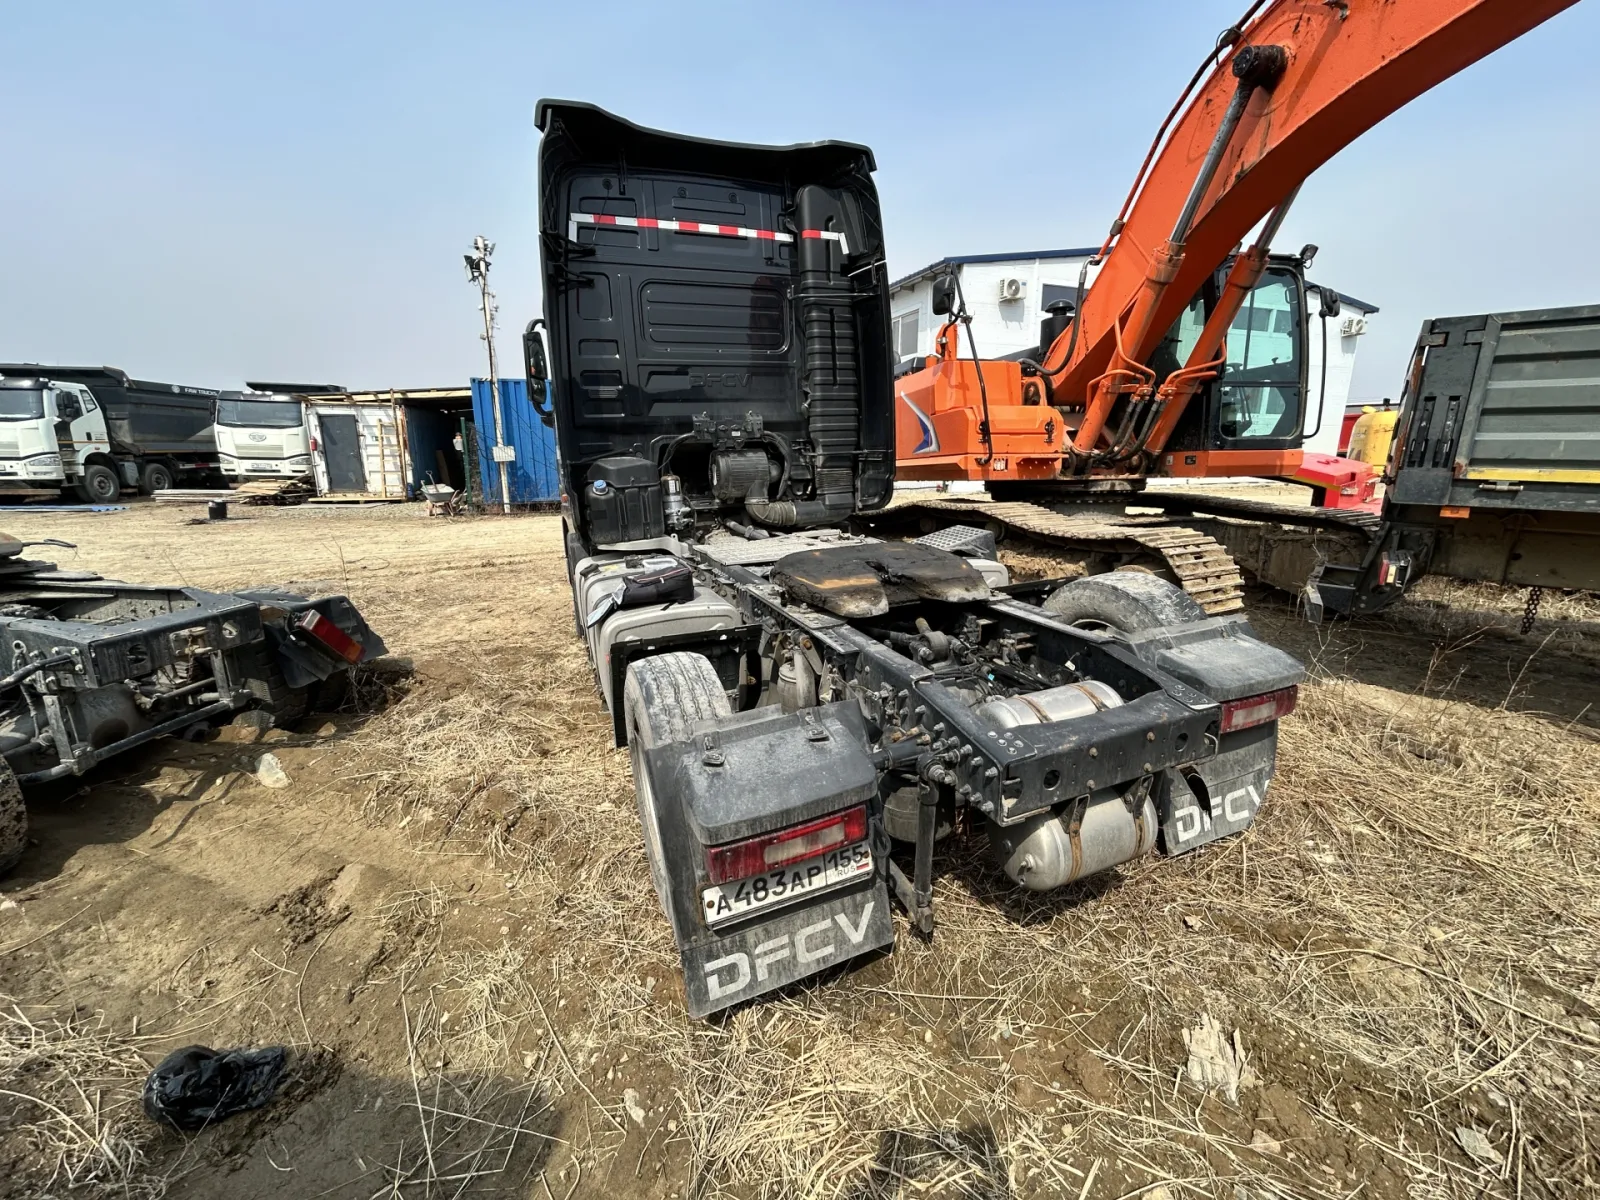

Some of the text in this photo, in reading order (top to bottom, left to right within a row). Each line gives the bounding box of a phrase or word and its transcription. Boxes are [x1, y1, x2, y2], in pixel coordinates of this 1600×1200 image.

[689, 373, 751, 388] DFCV
[828, 844, 864, 871] 155
[837, 866, 856, 877] RUS
[704, 901, 874, 1000] DFCV
